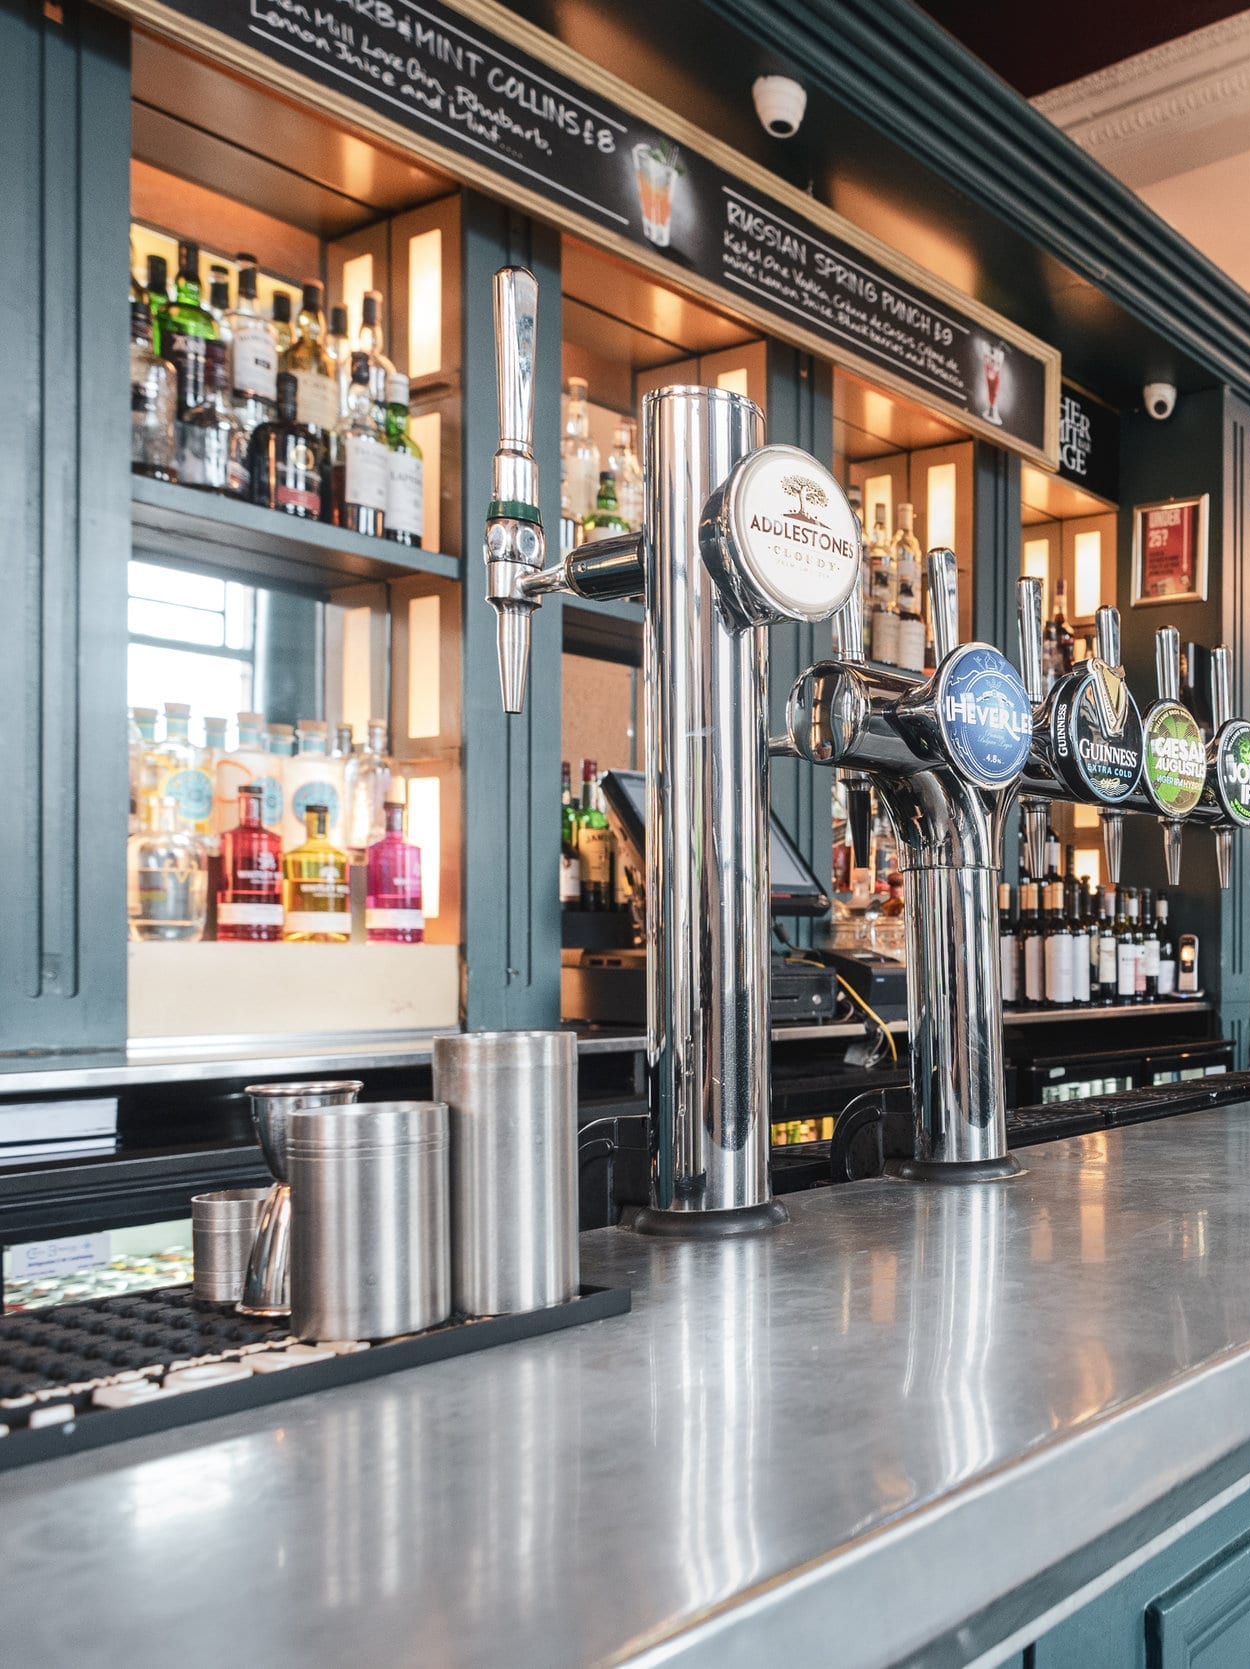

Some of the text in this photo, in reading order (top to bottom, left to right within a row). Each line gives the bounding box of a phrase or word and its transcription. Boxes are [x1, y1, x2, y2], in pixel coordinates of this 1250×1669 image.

[400, 83, 442, 112] and
[414, 21, 484, 77] MINT
[487, 66, 581, 135] COLLINS
[727, 201, 807, 265] RUSSIAN
[814, 253, 878, 303] SPRING
[881, 290, 931, 336] PUNCH
[1060, 443, 1087, 475] GE
[750, 513, 854, 560] ADDLESTONES
[1057, 703, 1068, 757] GUINNESS
[1079, 738, 1138, 769] GUINNESS
[1087, 762, 1133, 779] EXTRA COLD
